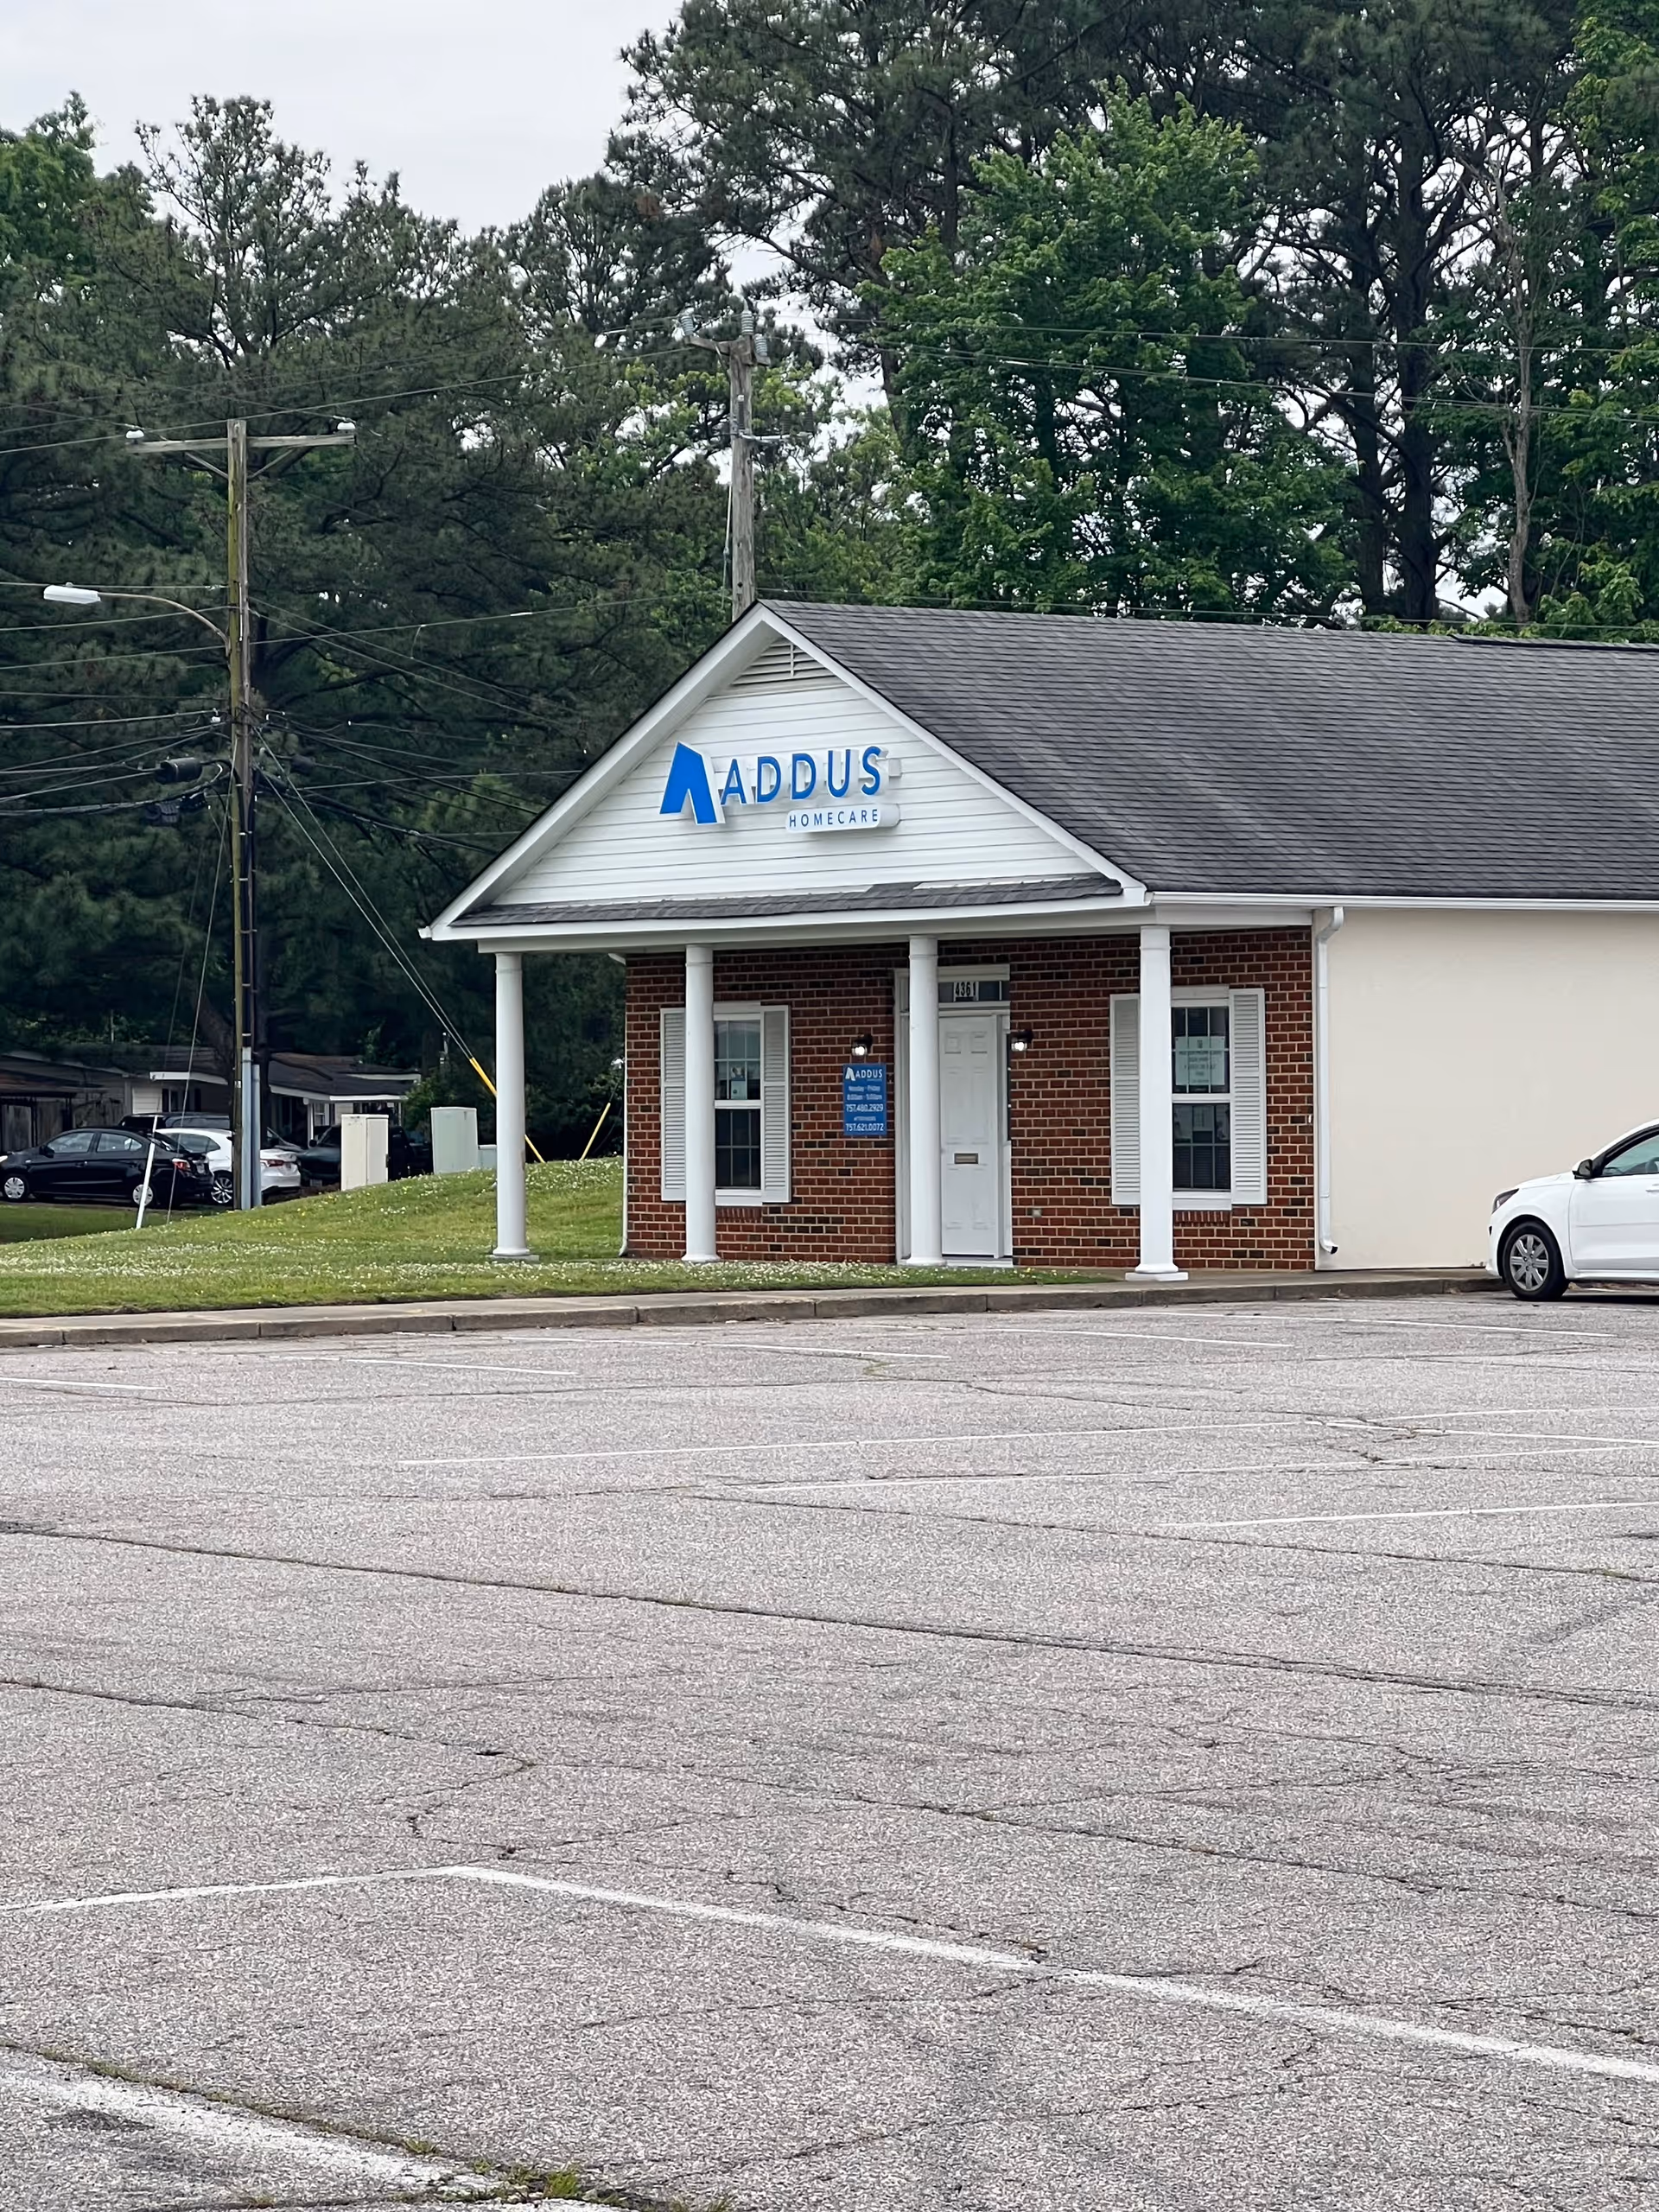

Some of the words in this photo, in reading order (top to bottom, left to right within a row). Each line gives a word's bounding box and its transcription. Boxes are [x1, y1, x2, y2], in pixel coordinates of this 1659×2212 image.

[720, 746, 881, 805] ADDUS
[789, 809, 879, 827] HOMECARE
[955, 982, 976, 996] 4361
[855, 1069, 883, 1078] ADDUS
[845, 1122, 884, 1131] 757.621.0072
